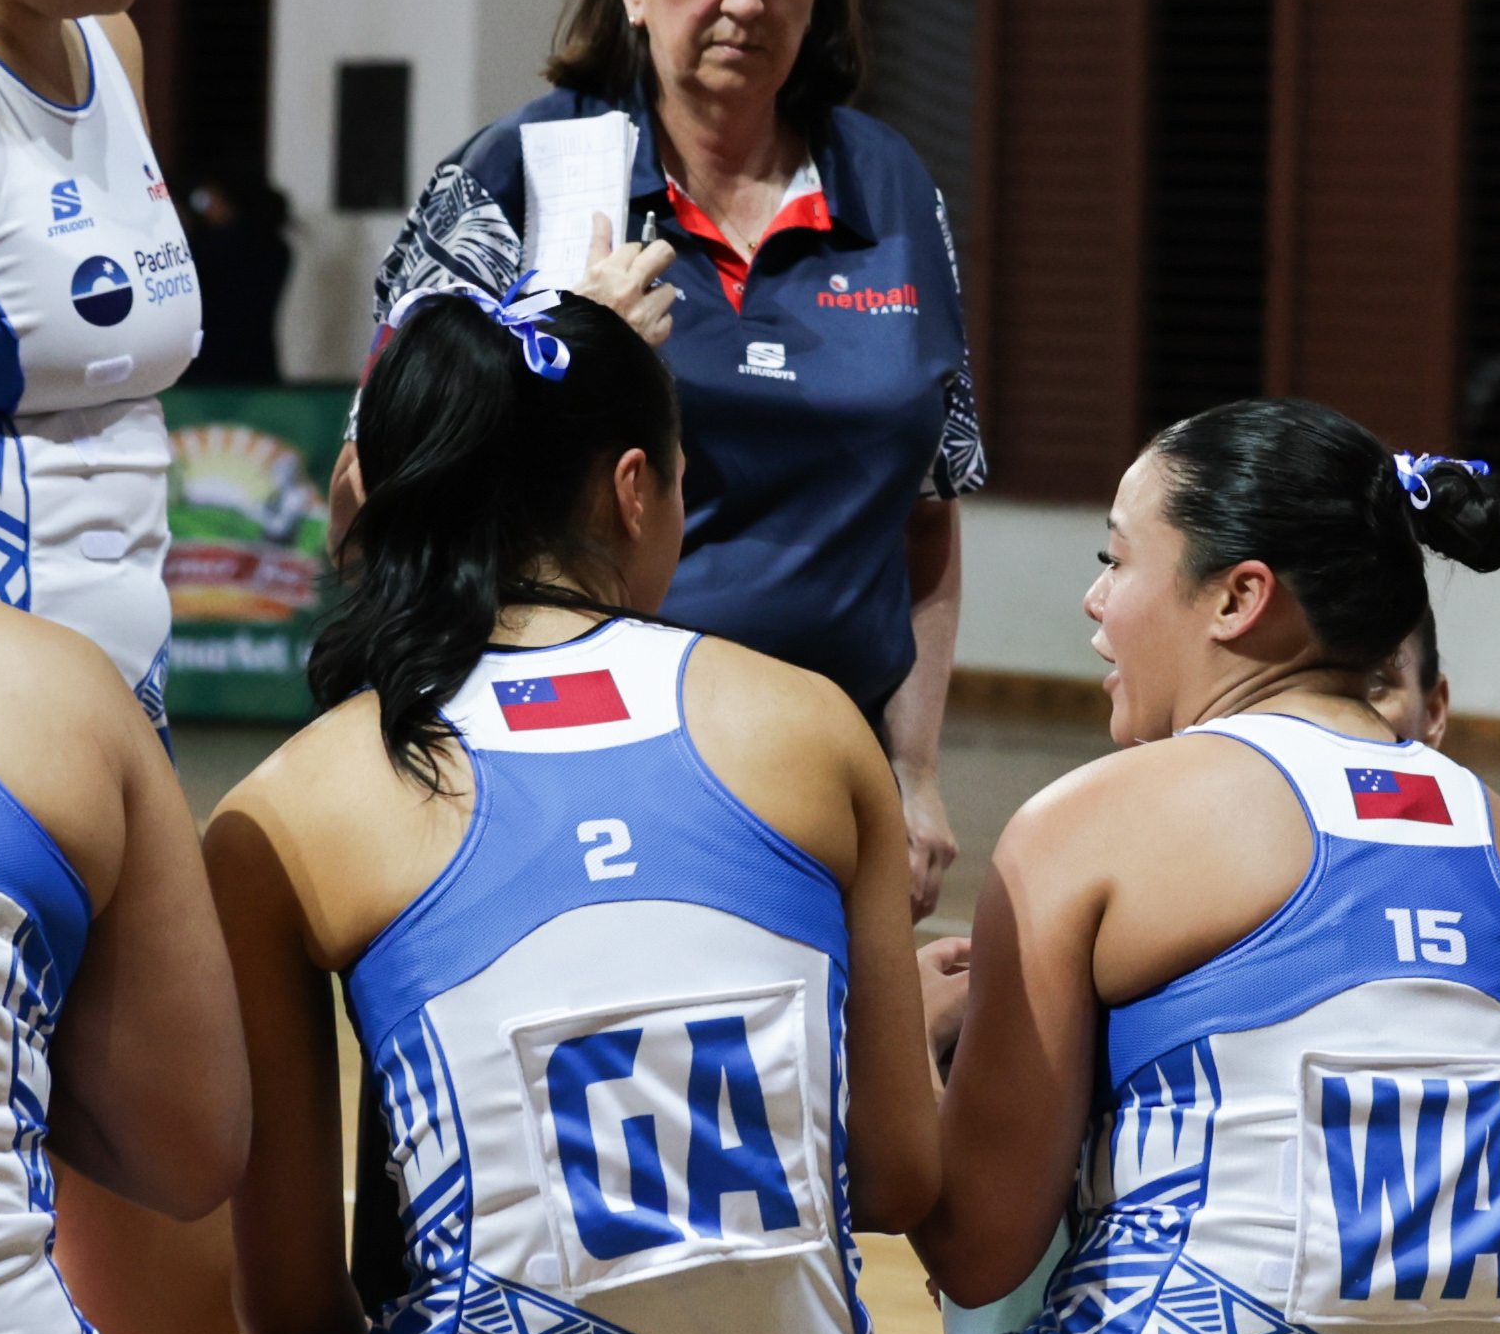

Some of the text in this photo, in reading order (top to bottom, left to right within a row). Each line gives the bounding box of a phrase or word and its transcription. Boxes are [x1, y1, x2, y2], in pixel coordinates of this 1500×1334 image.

[48, 217, 95, 237] STRUDDYS
[145, 271, 193, 307] Sports
[817, 283, 918, 312] netball
[870, 303, 919, 316] SAMOA
[738, 364, 797, 381] STRUDDYS
[576, 818, 638, 881] 2
[1384, 907, 1468, 966] 15
[546, 1016, 800, 1261] GA
